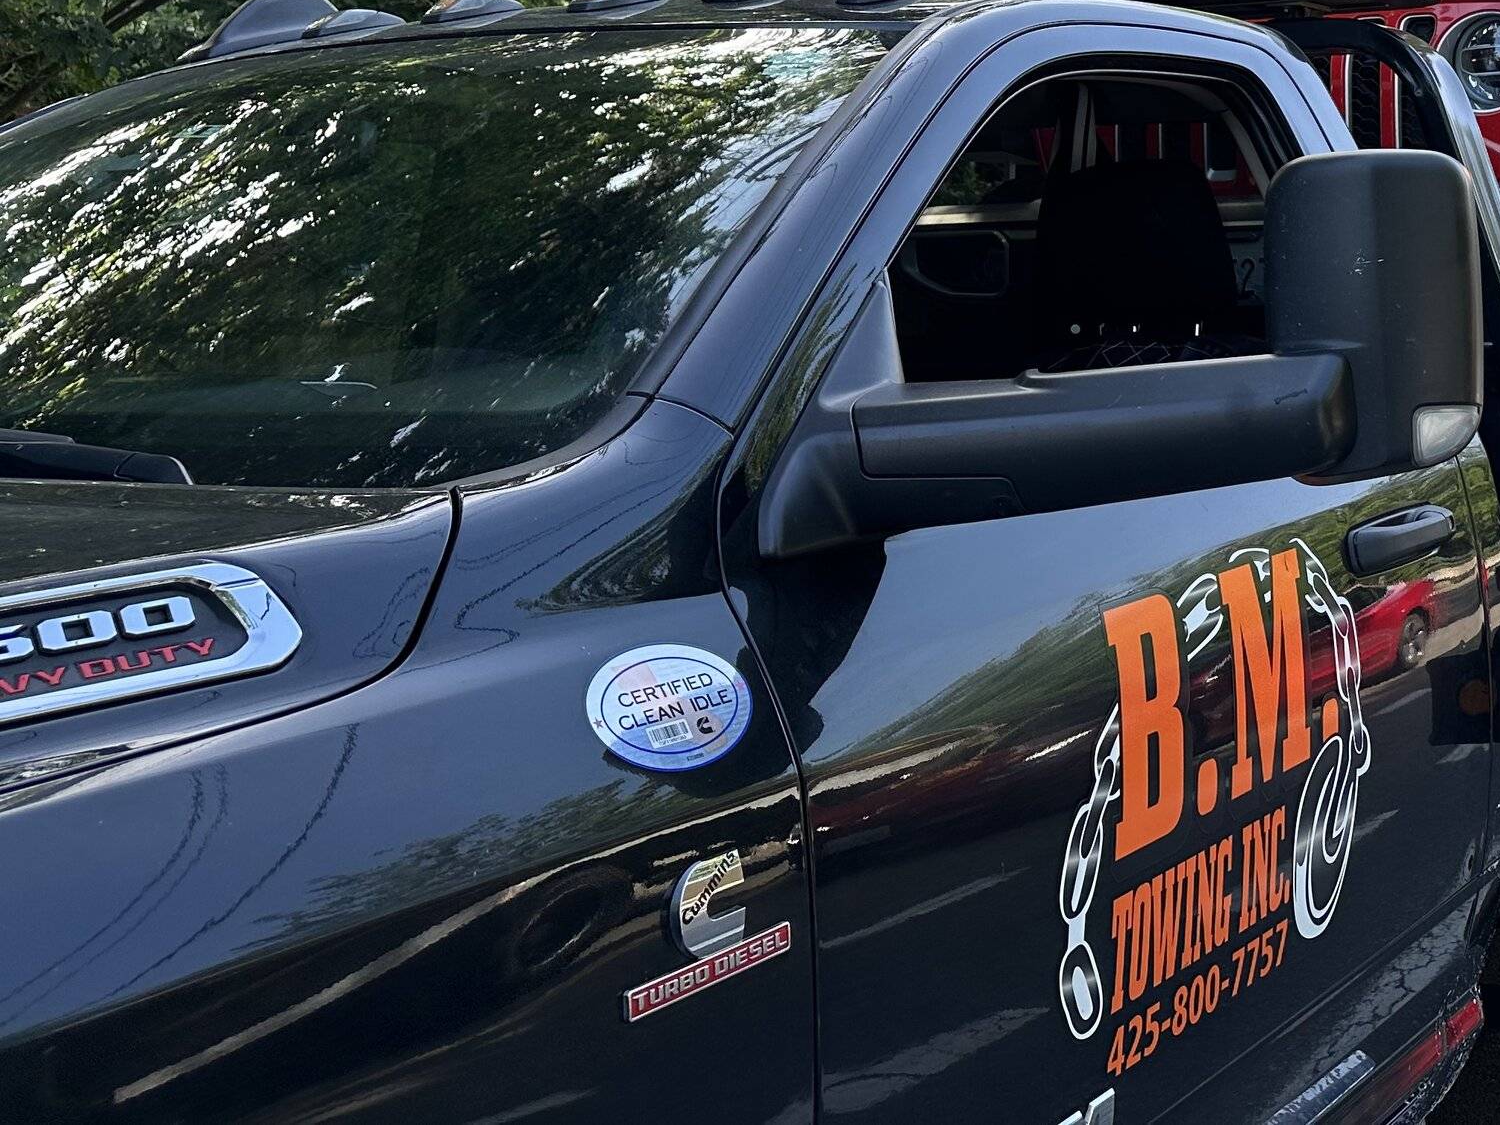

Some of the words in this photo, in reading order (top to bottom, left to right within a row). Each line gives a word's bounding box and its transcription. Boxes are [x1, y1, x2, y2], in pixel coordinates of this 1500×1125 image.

[77, 638, 215, 679] DUTY
[617, 672, 713, 707] CERTIFIED
[618, 701, 684, 730] CLEAN
[689, 688, 732, 712] IDLE
[1110, 834, 1233, 1015] TOWING
[1239, 805, 1290, 933] INC.
[632, 964, 710, 1011] TURBO
[714, 930, 788, 975] DIESEL
[1106, 918, 1289, 1077] 425-800-7757
